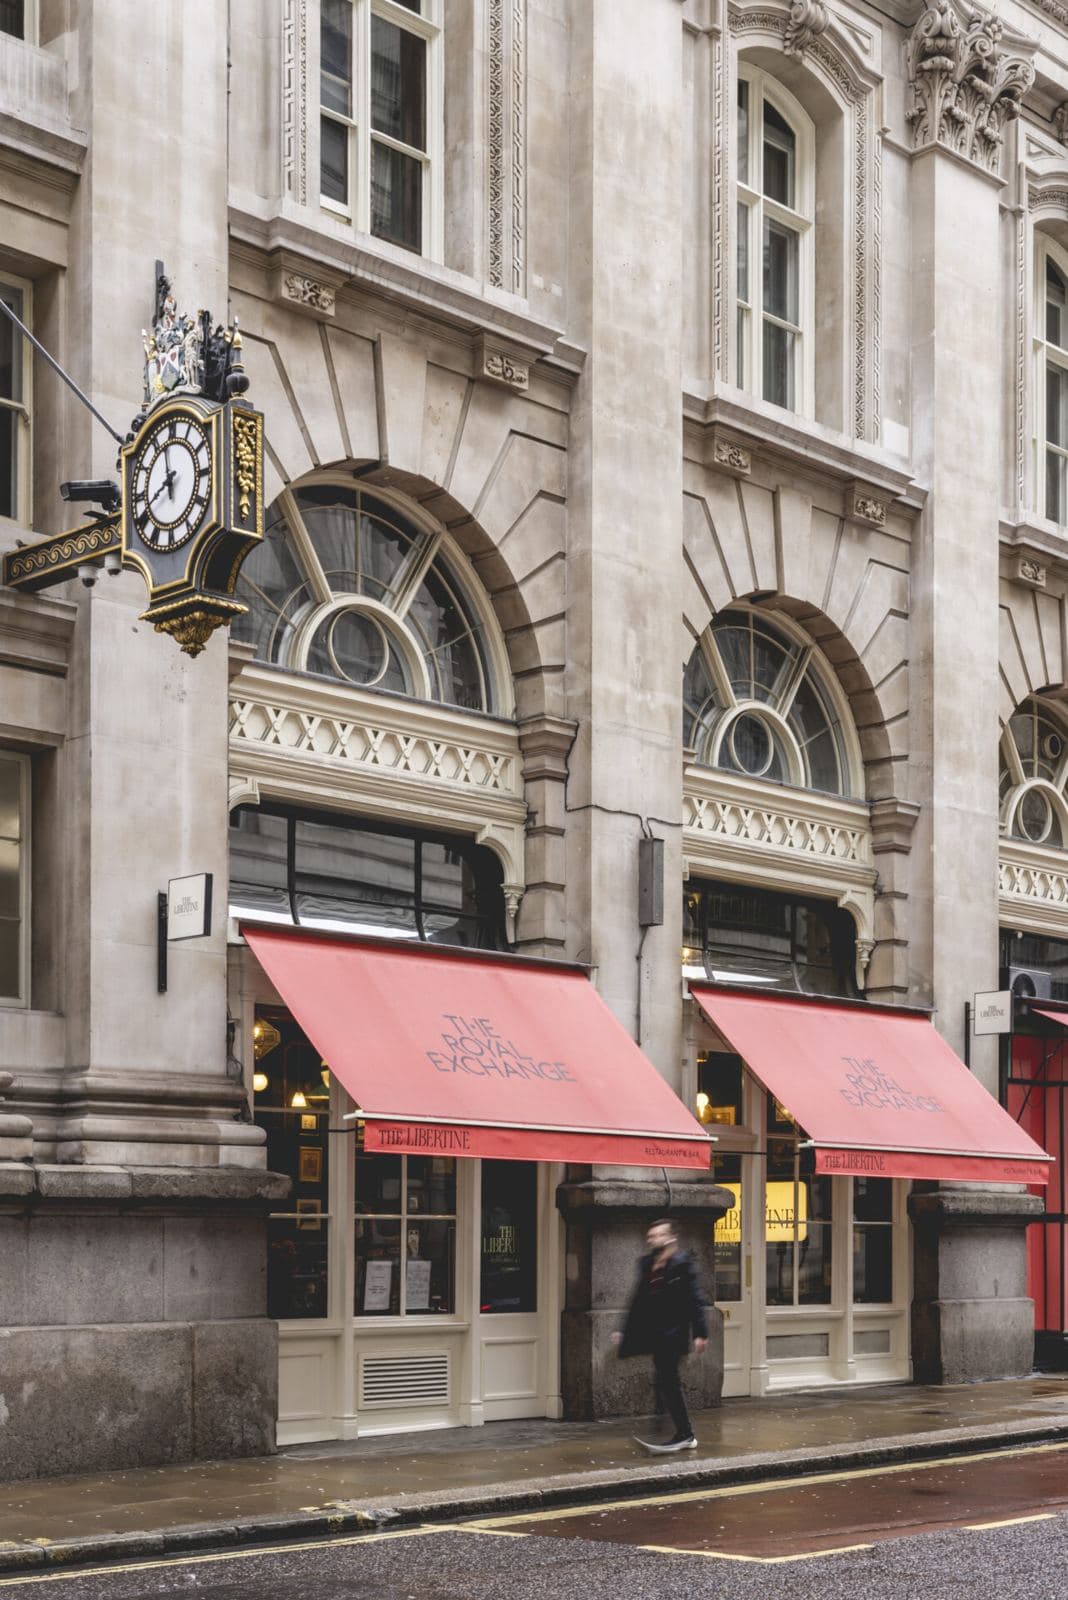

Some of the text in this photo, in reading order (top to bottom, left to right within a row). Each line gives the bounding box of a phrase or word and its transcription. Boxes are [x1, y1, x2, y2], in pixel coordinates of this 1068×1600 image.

[442, 1014, 502, 1039] THE
[441, 1033, 533, 1060] ROYAL
[426, 1051, 577, 1082] EXCHANGE
[841, 1057, 885, 1077] THE
[845, 1074, 912, 1095] ROYAL
[840, 1089, 945, 1113] EXCHANGE
[378, 1127, 470, 1150] THE LIBERTINE
[825, 1151, 885, 1171] THE LIBERTINE
